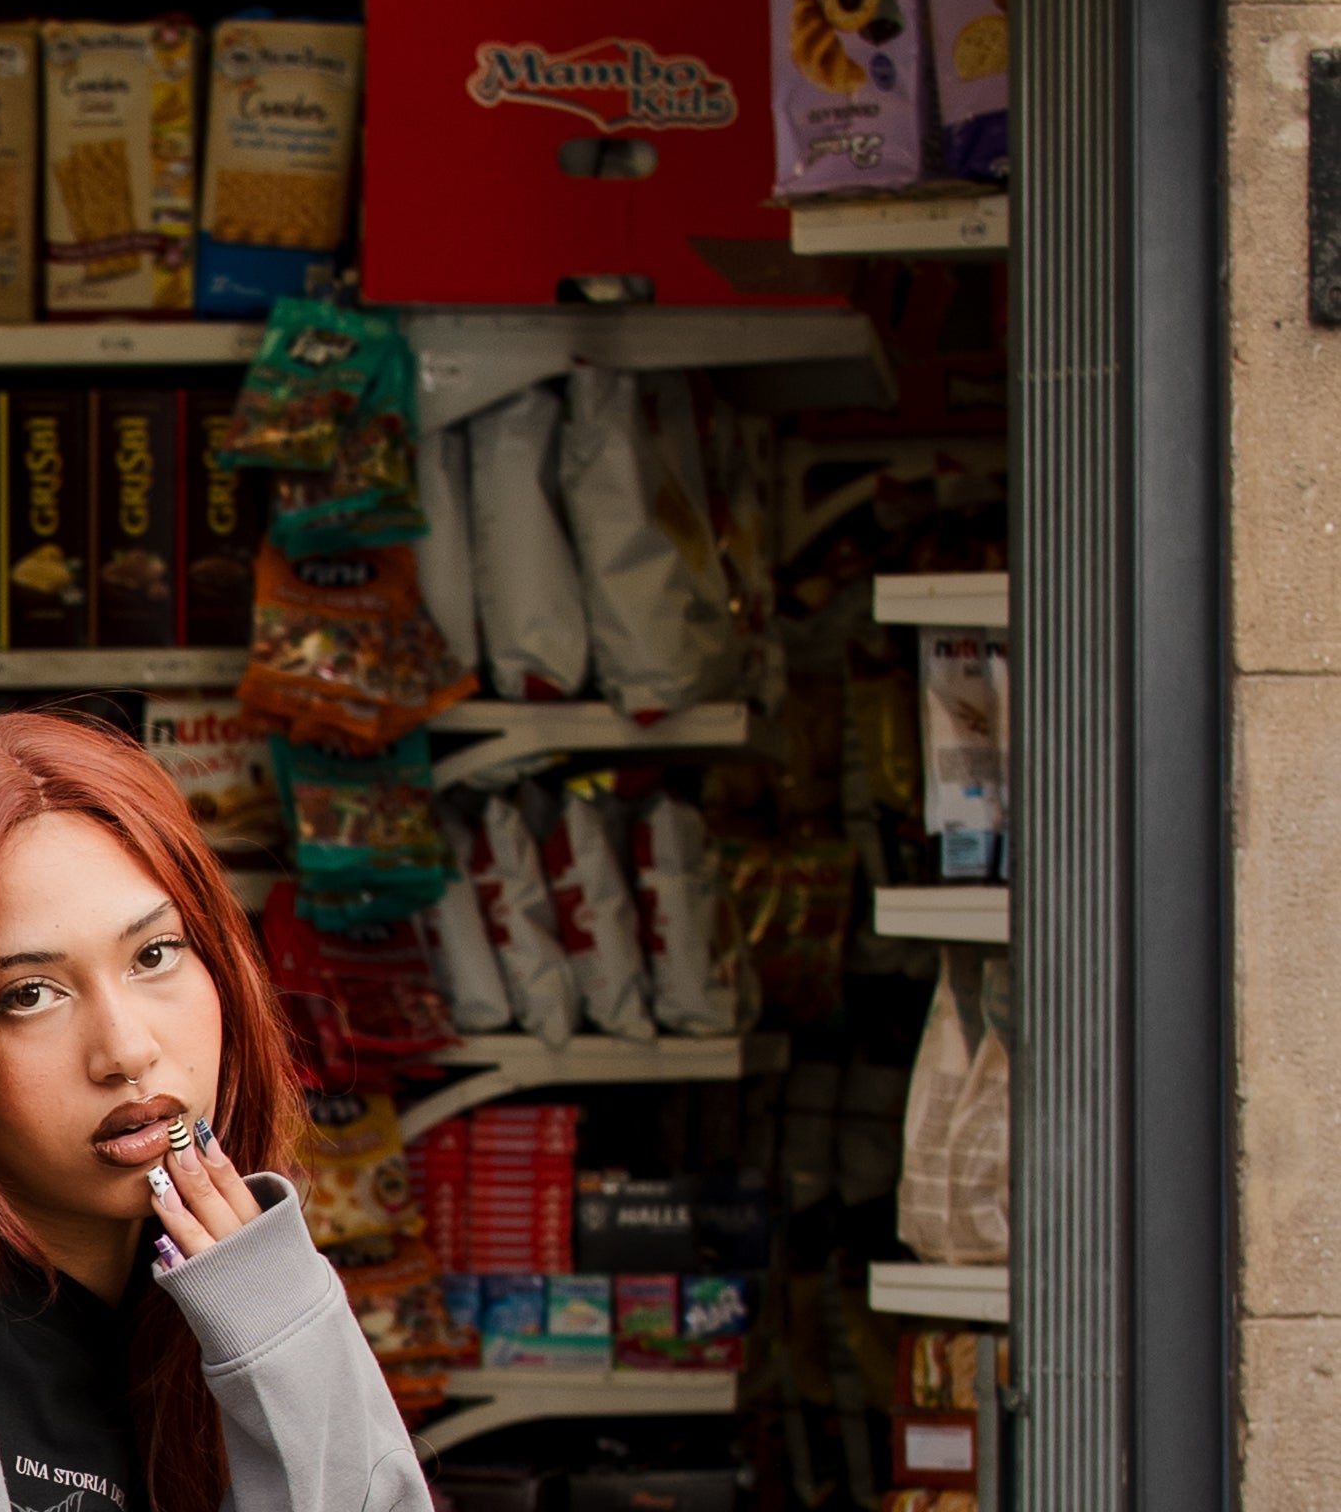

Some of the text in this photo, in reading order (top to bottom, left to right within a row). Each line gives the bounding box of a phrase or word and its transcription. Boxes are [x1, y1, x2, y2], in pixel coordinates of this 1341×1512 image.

[489, 45, 699, 90] Mambo
[630, 85, 729, 118] Kids
[14, 1455, 49, 1481] UNA
[52, 1467, 108, 1498] STORIA
